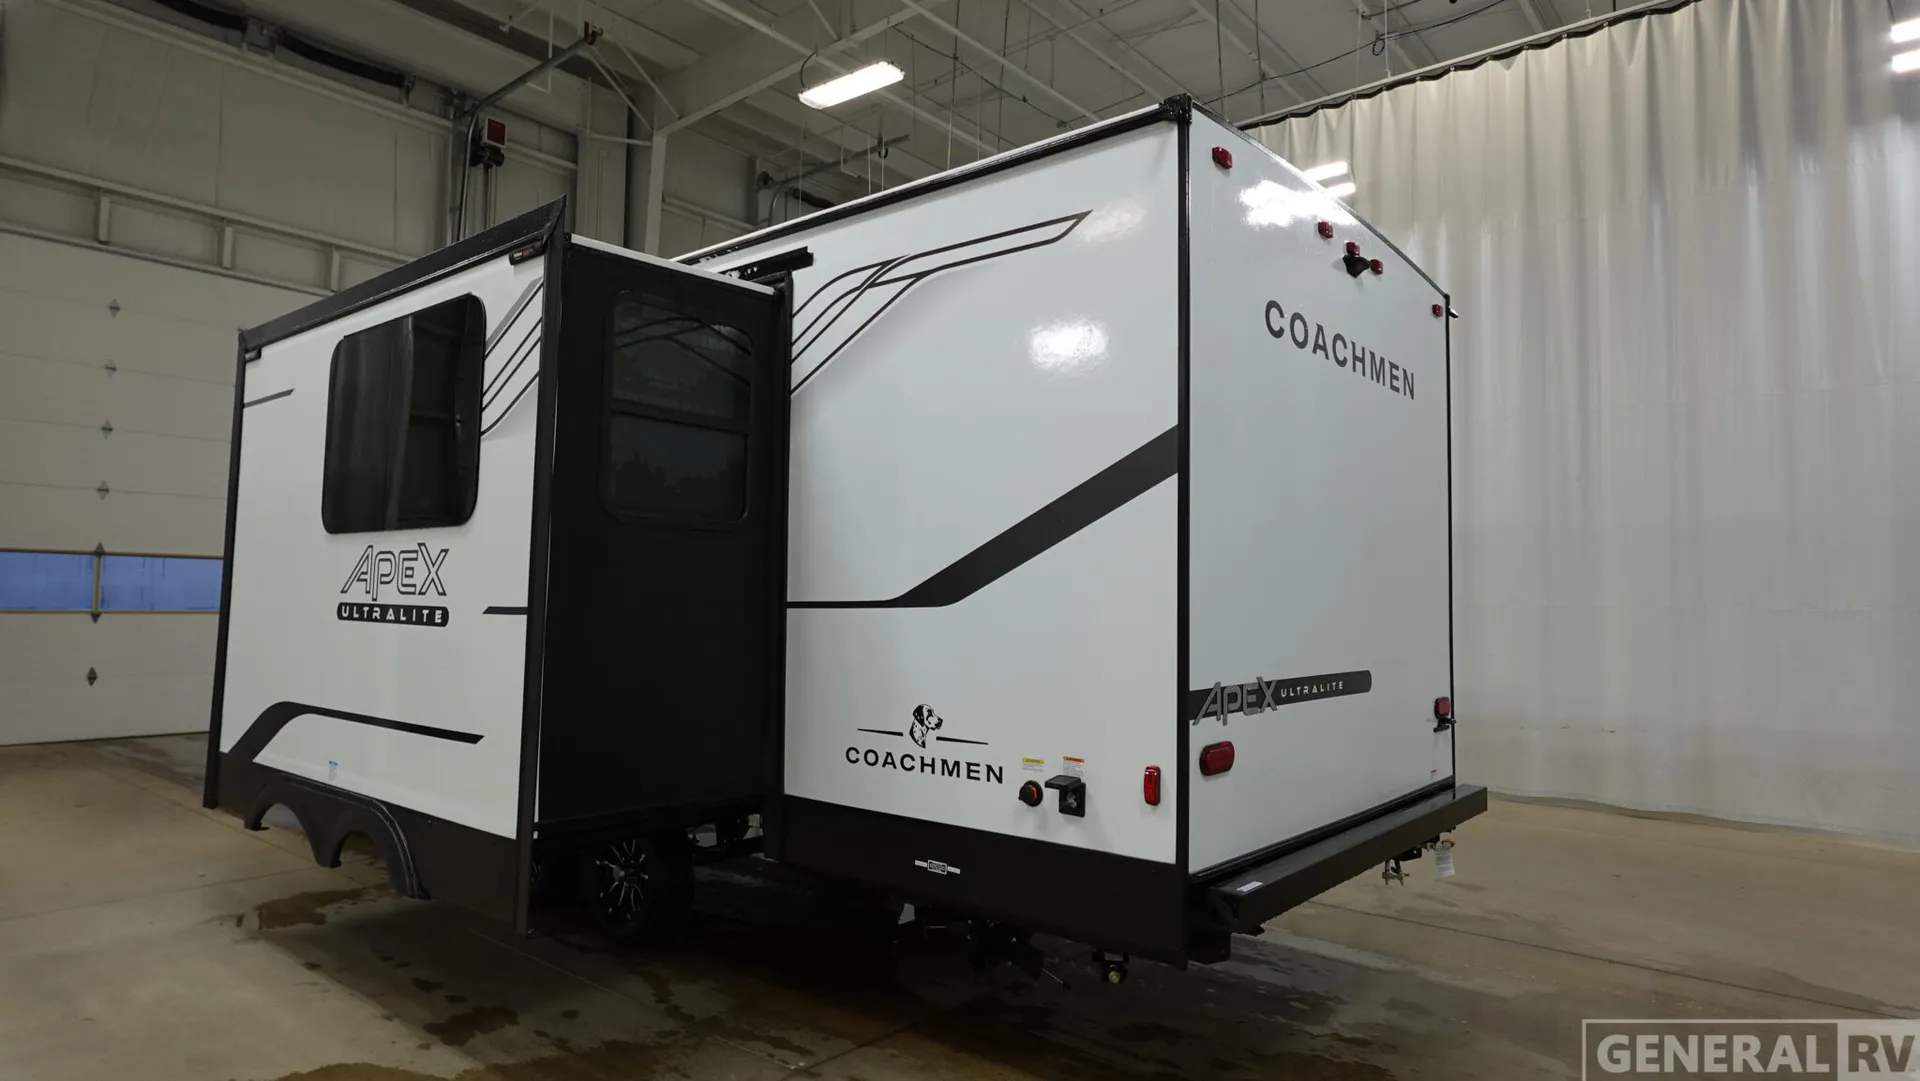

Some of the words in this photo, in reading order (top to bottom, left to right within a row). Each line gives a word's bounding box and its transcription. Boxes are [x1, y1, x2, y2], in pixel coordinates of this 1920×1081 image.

[1265, 300, 1414, 400] COACHMEN
[340, 542, 450, 602] APEX
[341, 605, 443, 623] ULTRALITE
[1192, 676, 1278, 726] APEX
[1280, 681, 1344, 698] ULTRALITE
[845, 747, 1003, 784] COACHMEN
